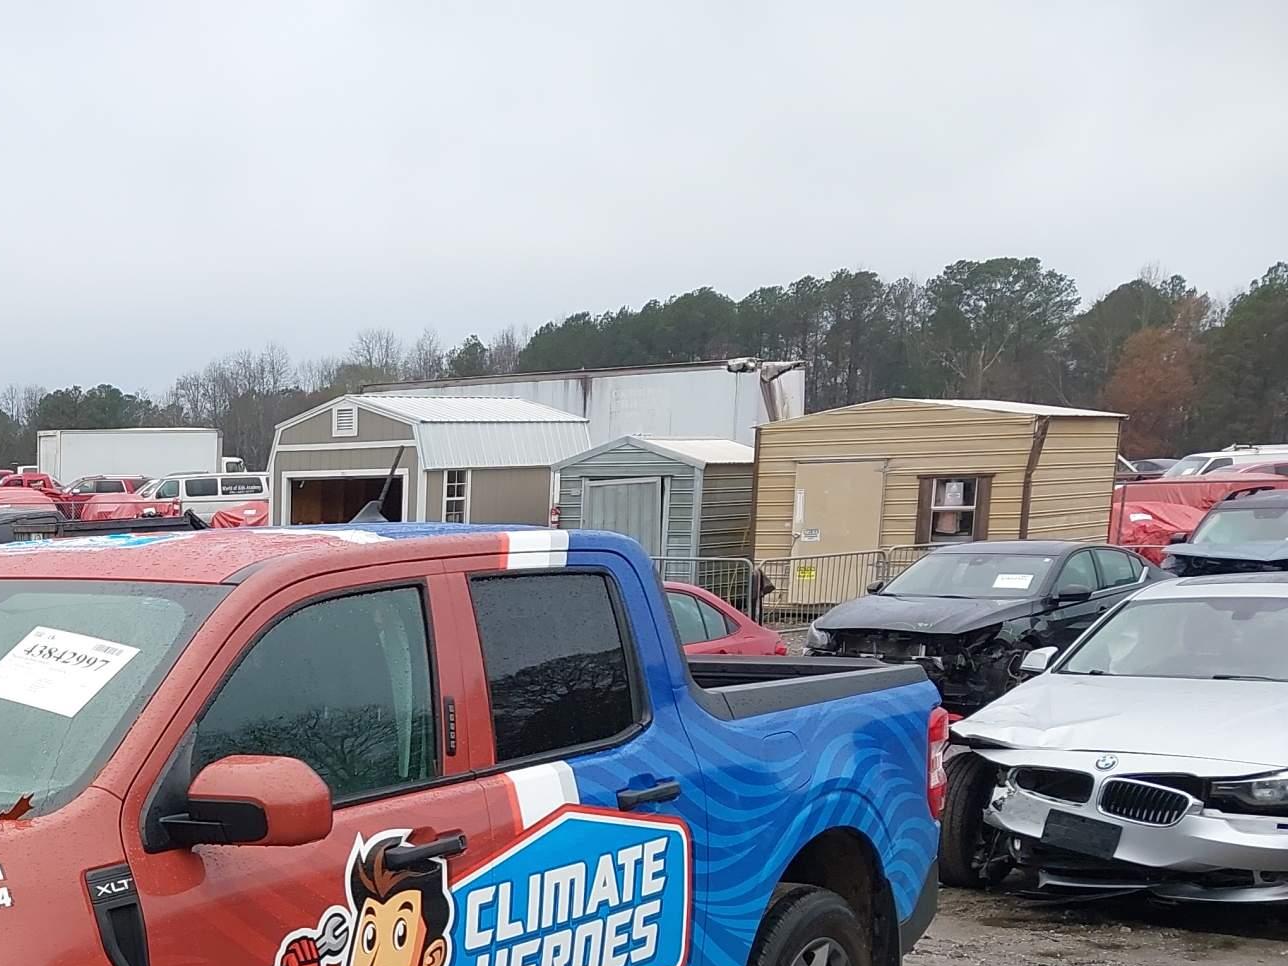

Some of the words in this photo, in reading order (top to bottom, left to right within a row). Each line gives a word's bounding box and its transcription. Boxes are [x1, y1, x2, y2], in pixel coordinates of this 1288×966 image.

[23, 642, 111, 672] 43842997
[95, 878, 133, 897] XLT
[465, 837, 669, 951] CLIMATE
